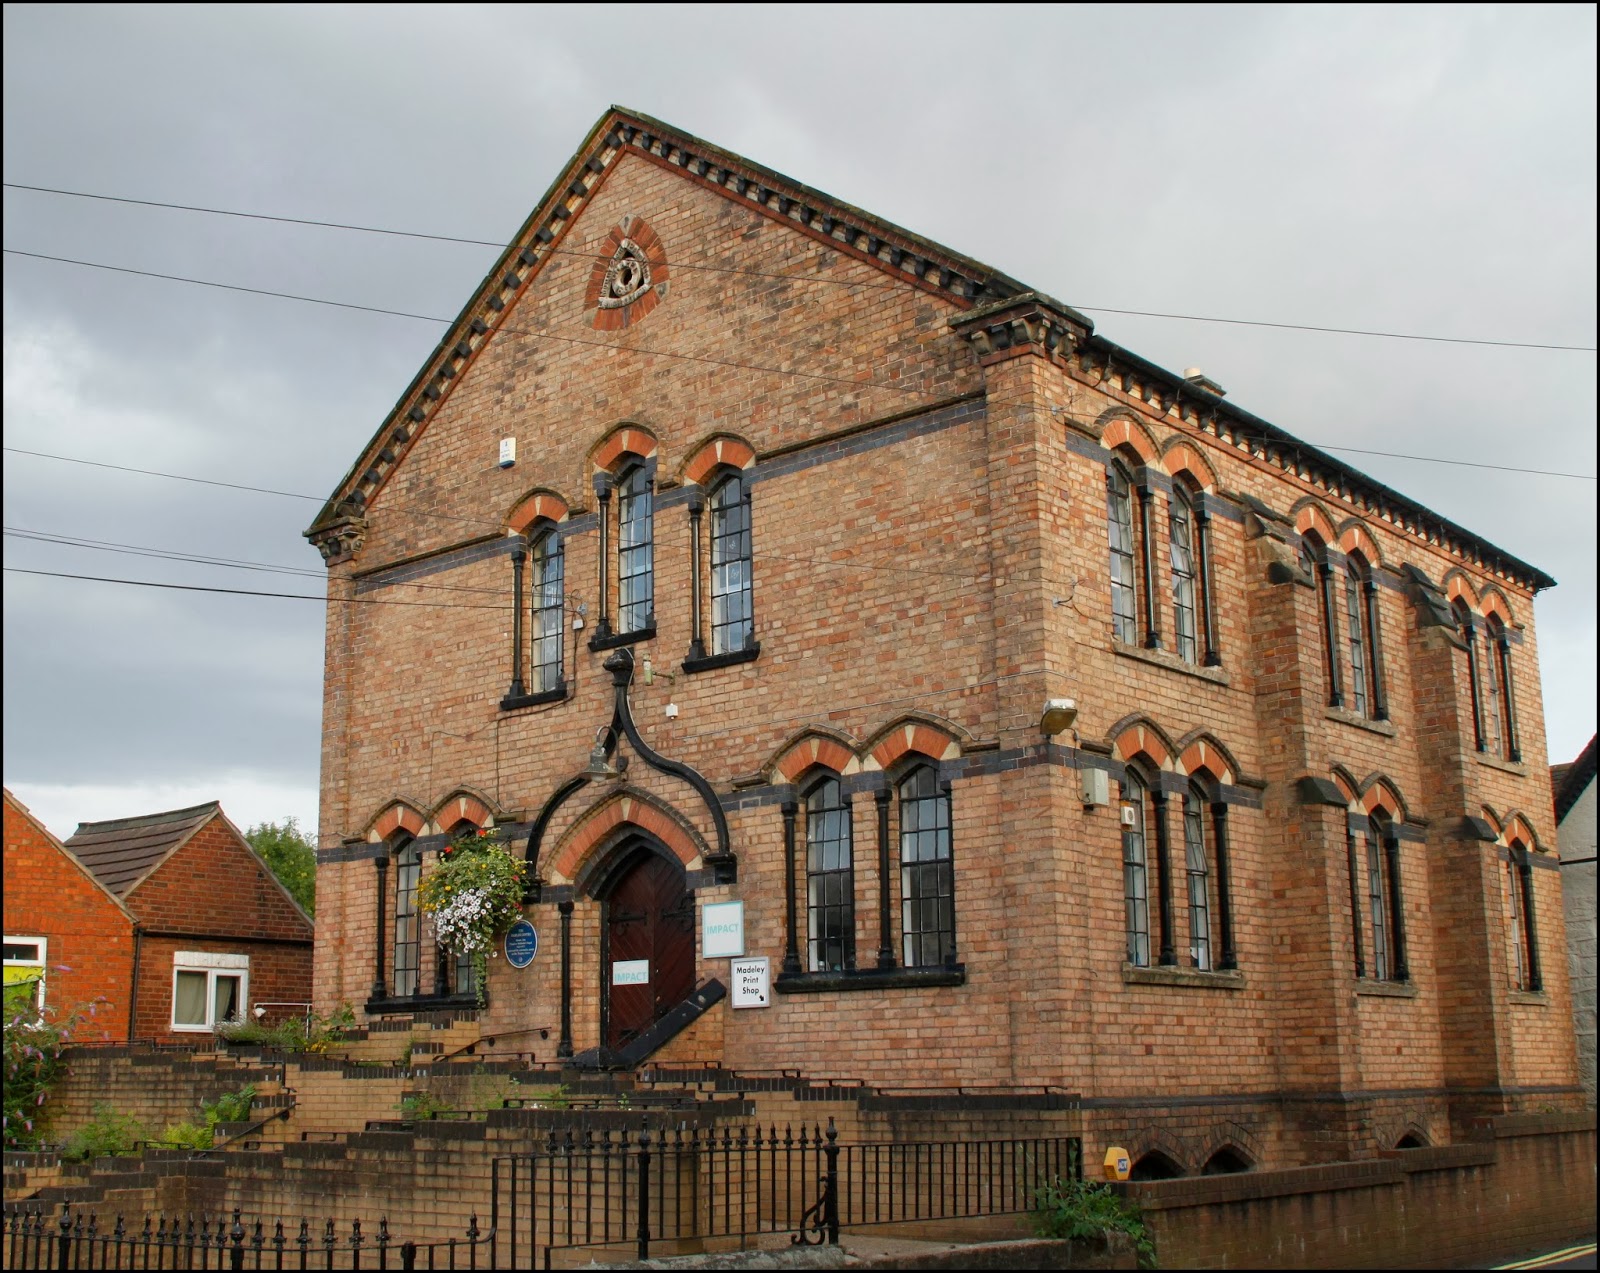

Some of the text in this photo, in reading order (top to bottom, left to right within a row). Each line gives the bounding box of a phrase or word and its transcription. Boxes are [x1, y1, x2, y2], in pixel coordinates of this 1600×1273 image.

[706, 923, 739, 935] IMPACT
[736, 965, 765, 974] Madeley
[614, 971, 647, 982] IMPACT
[742, 976, 759, 984] Print
[742, 986, 760, 995] Shop
